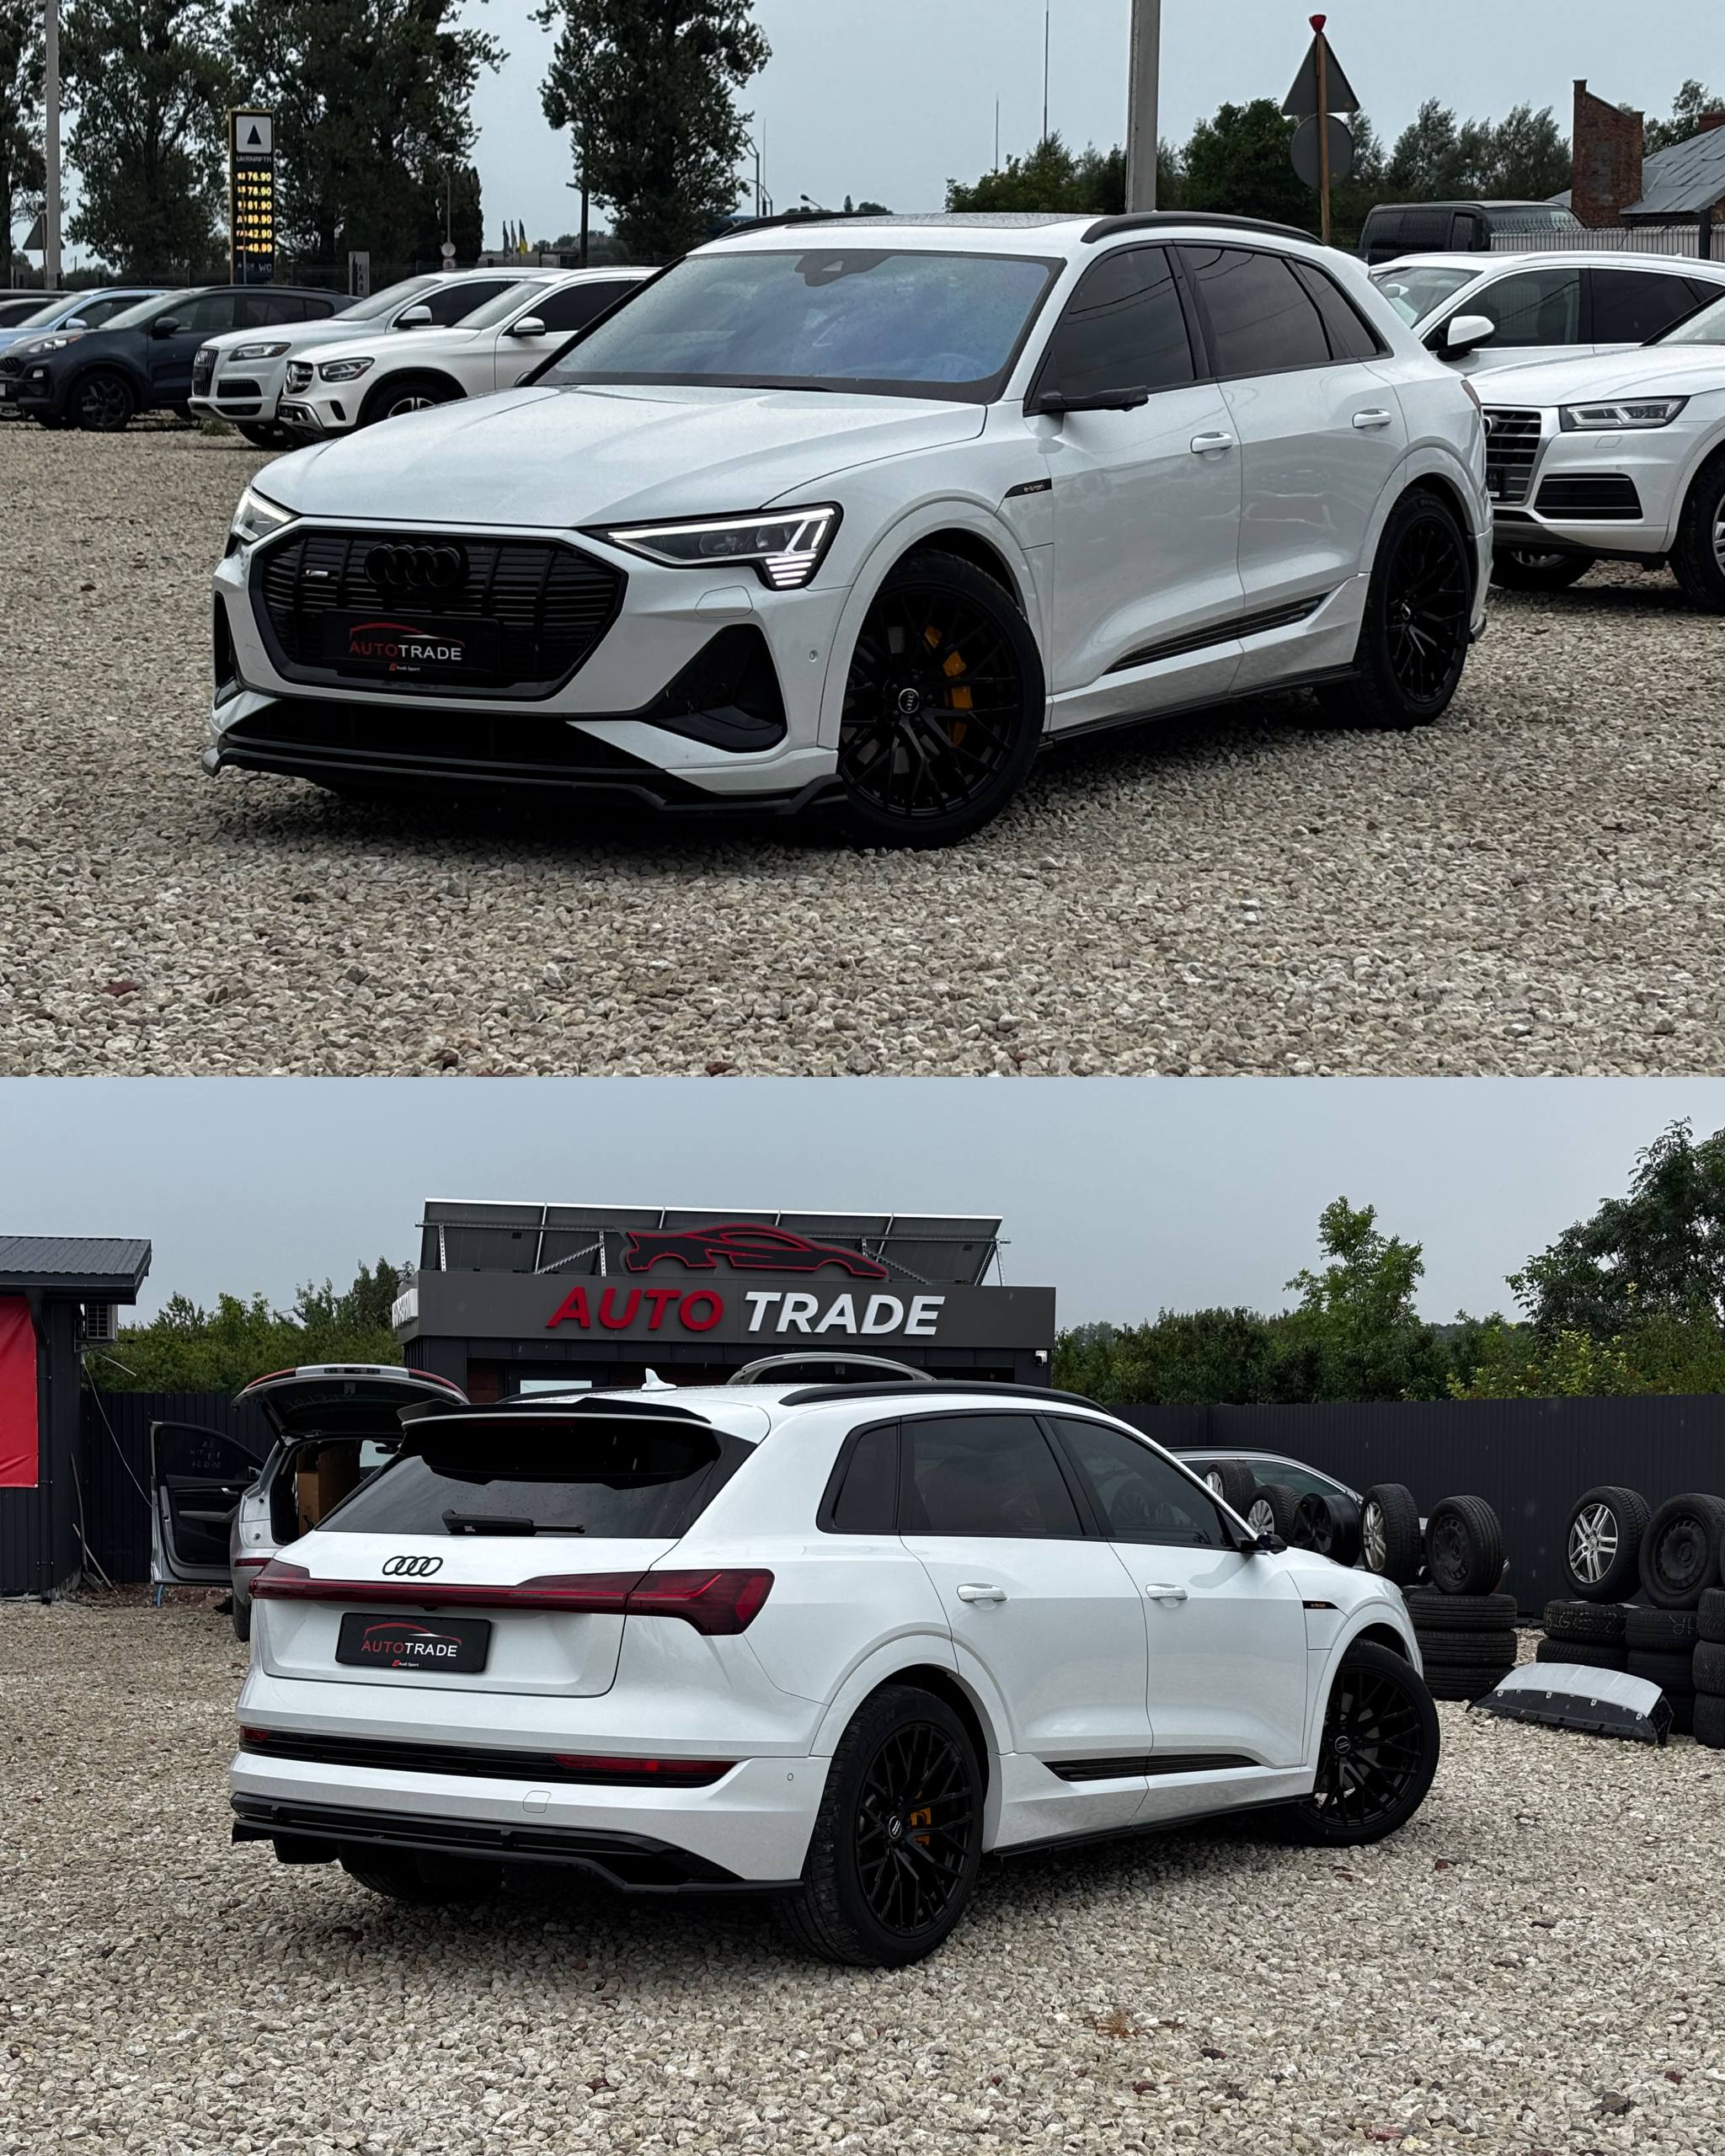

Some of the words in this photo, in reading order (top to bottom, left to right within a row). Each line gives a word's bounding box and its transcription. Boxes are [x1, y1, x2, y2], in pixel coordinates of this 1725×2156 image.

[349, 640, 462, 661] AUTOTRADE
[545, 1286, 724, 1331] AUTO
[744, 1290, 947, 1336] TRADE
[361, 1640, 458, 1657] AUTOTRADE
